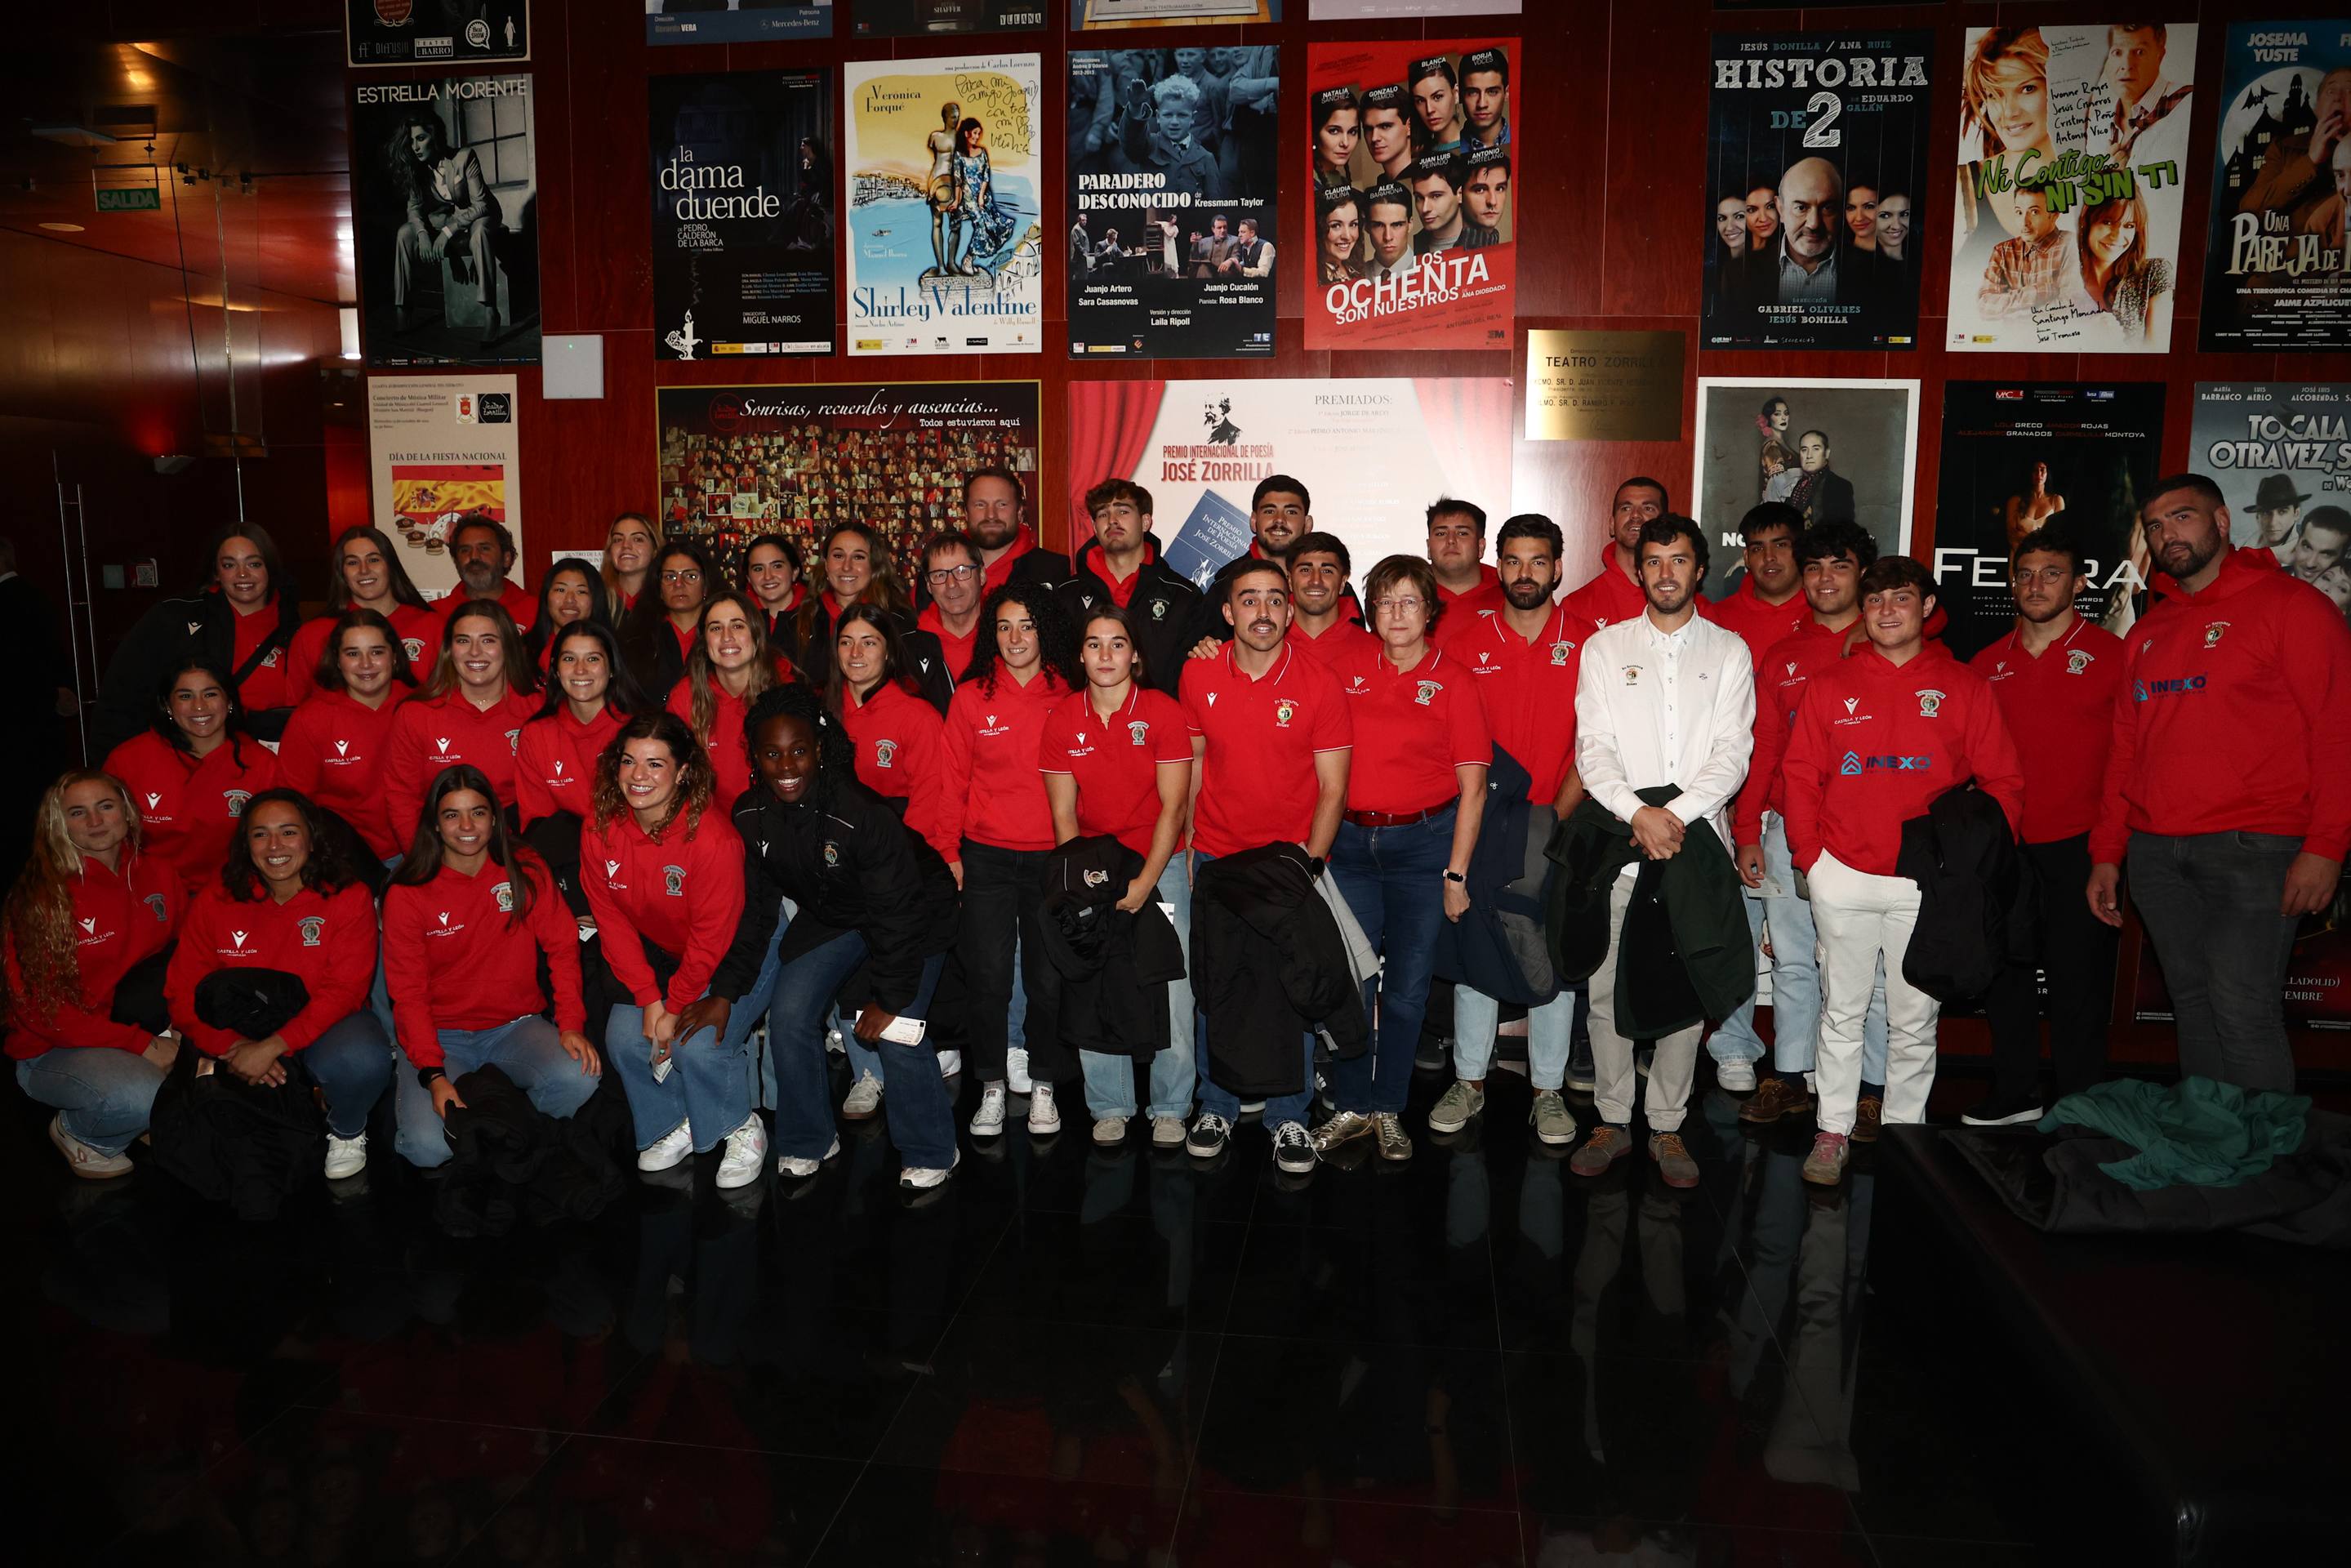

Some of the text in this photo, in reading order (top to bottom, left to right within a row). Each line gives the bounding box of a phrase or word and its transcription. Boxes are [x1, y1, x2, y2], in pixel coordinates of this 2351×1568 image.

[933, 6, 962, 14] SHAFFER
[681, 23, 697, 32] VERA
[771, 19, 820, 28] Mercedes-Benz
[1739, 40, 1892, 52] JESÚS BONILLA ANA RUIZ
[2246, 32, 2309, 47] JOSEMA
[421, 47, 452, 56] BARRO
[1472, 51, 1493, 61] BORJA
[2253, 47, 2300, 63] YUSTE
[1421, 56, 1446, 67] BLANCA
[1714, 56, 1929, 89] HISTORIA
[357, 78, 529, 105] ESTRELLA MORENTE
[1322, 87, 1350, 98] NATALIA
[1369, 85, 1399, 98] GONZALO
[2050, 81, 2109, 100] Ivonne Reyes
[866, 96, 906, 114] Forqué
[1861, 94, 1914, 104] EDUARDO
[1846, 103, 1884, 112] GALÁN
[1770, 91, 1842, 148] DE 2
[2054, 109, 2117, 129] Cristina Peña
[2055, 125, 2108, 145] Antonio Vico
[679, 145, 694, 163] la
[1418, 152, 1451, 165] JUAN LUIS
[1472, 147, 1501, 159] ANTONIO
[660, 157, 746, 191] dama
[1976, 154, 2014, 201] Ni
[1077, 172, 1167, 190] PARADERO
[1378, 182, 1395, 192] ALEX
[2045, 159, 2180, 215] NI SIN TI
[1325, 185, 1351, 196] CLAUDIA
[98, 189, 158, 209] SALIDA
[675, 185, 781, 221] duende
[1077, 191, 1192, 211] DESCONOCIDO
[1194, 198, 1264, 208] Kressmann Taylor
[2263, 209, 2291, 233] UNA
[677, 229, 717, 240] CALDERÓN
[683, 223, 709, 233] PEDRO
[677, 238, 724, 248] DE LA BARCA
[2223, 211, 2341, 278] PAREJA DE
[1412, 250, 1444, 270] LOS
[1084, 284, 1133, 294] Juanjo Artero
[1203, 282, 1259, 292] Juanjo Cucalón
[1325, 252, 1490, 315] OCHENTA
[1461, 283, 1507, 300] ANA DIOSDADO
[853, 284, 1038, 323] Shirley Valentine
[1078, 297, 1139, 306] Sara Casasnovas
[1218, 296, 1264, 305] Rosa Blanco
[1334, 286, 1460, 326] SON NUESTROS
[2273, 299, 2303, 307] JAIME
[1757, 305, 1861, 314] GABRIEL OLIVARES
[742, 316, 771, 325] MIGUEL
[771, 314, 802, 324] NARROS
[1150, 317, 1191, 327] Laila Ripoll
[1768, 314, 1849, 324] JESÚS BONILLA
[2031, 307, 2108, 327] Santiago Moncada
[1545, 356, 1597, 368] TEATRO
[738, 398, 812, 419] Sonrisas,
[818, 387, 890, 416] recuerdos
[906, 400, 1000, 416] ausencias...
[1314, 394, 1393, 406] PREMIADOS:
[2201, 393, 2340, 402] BARRANCO MERLO ALCOBENDAS
[919, 416, 1022, 427] Todos estuvieron aquí
[2015, 421, 2109, 430] GRECO ROJAS
[2247, 413, 2349, 442] TOCALA
[2006, 430, 2146, 439] GRANADOS MONTOYA
[1163, 442, 1274, 458] PREMIO INTERNACIONAL DE POESÍA
[389, 452, 508, 462] DÍA DE LA FIESTA NACIONAL
[2207, 440, 2335, 475] OTRA VEZ,
[1160, 458, 1274, 482] JOSÉ ZORRILLA
[1202, 513, 1250, 551] INTERNACIONAL
[1207, 526, 1217, 537] DE
[1218, 515, 1244, 537] PREMIO
[1193, 528, 1211, 545] JOSÉ
[1932, 547, 2148, 590] FERA
[2151, 675, 2207, 693] INEXO
[1865, 755, 1932, 770] INEXO
[2291, 976, 2341, 988] LADOLID)
[2284, 991, 2325, 1001] EMBRE
